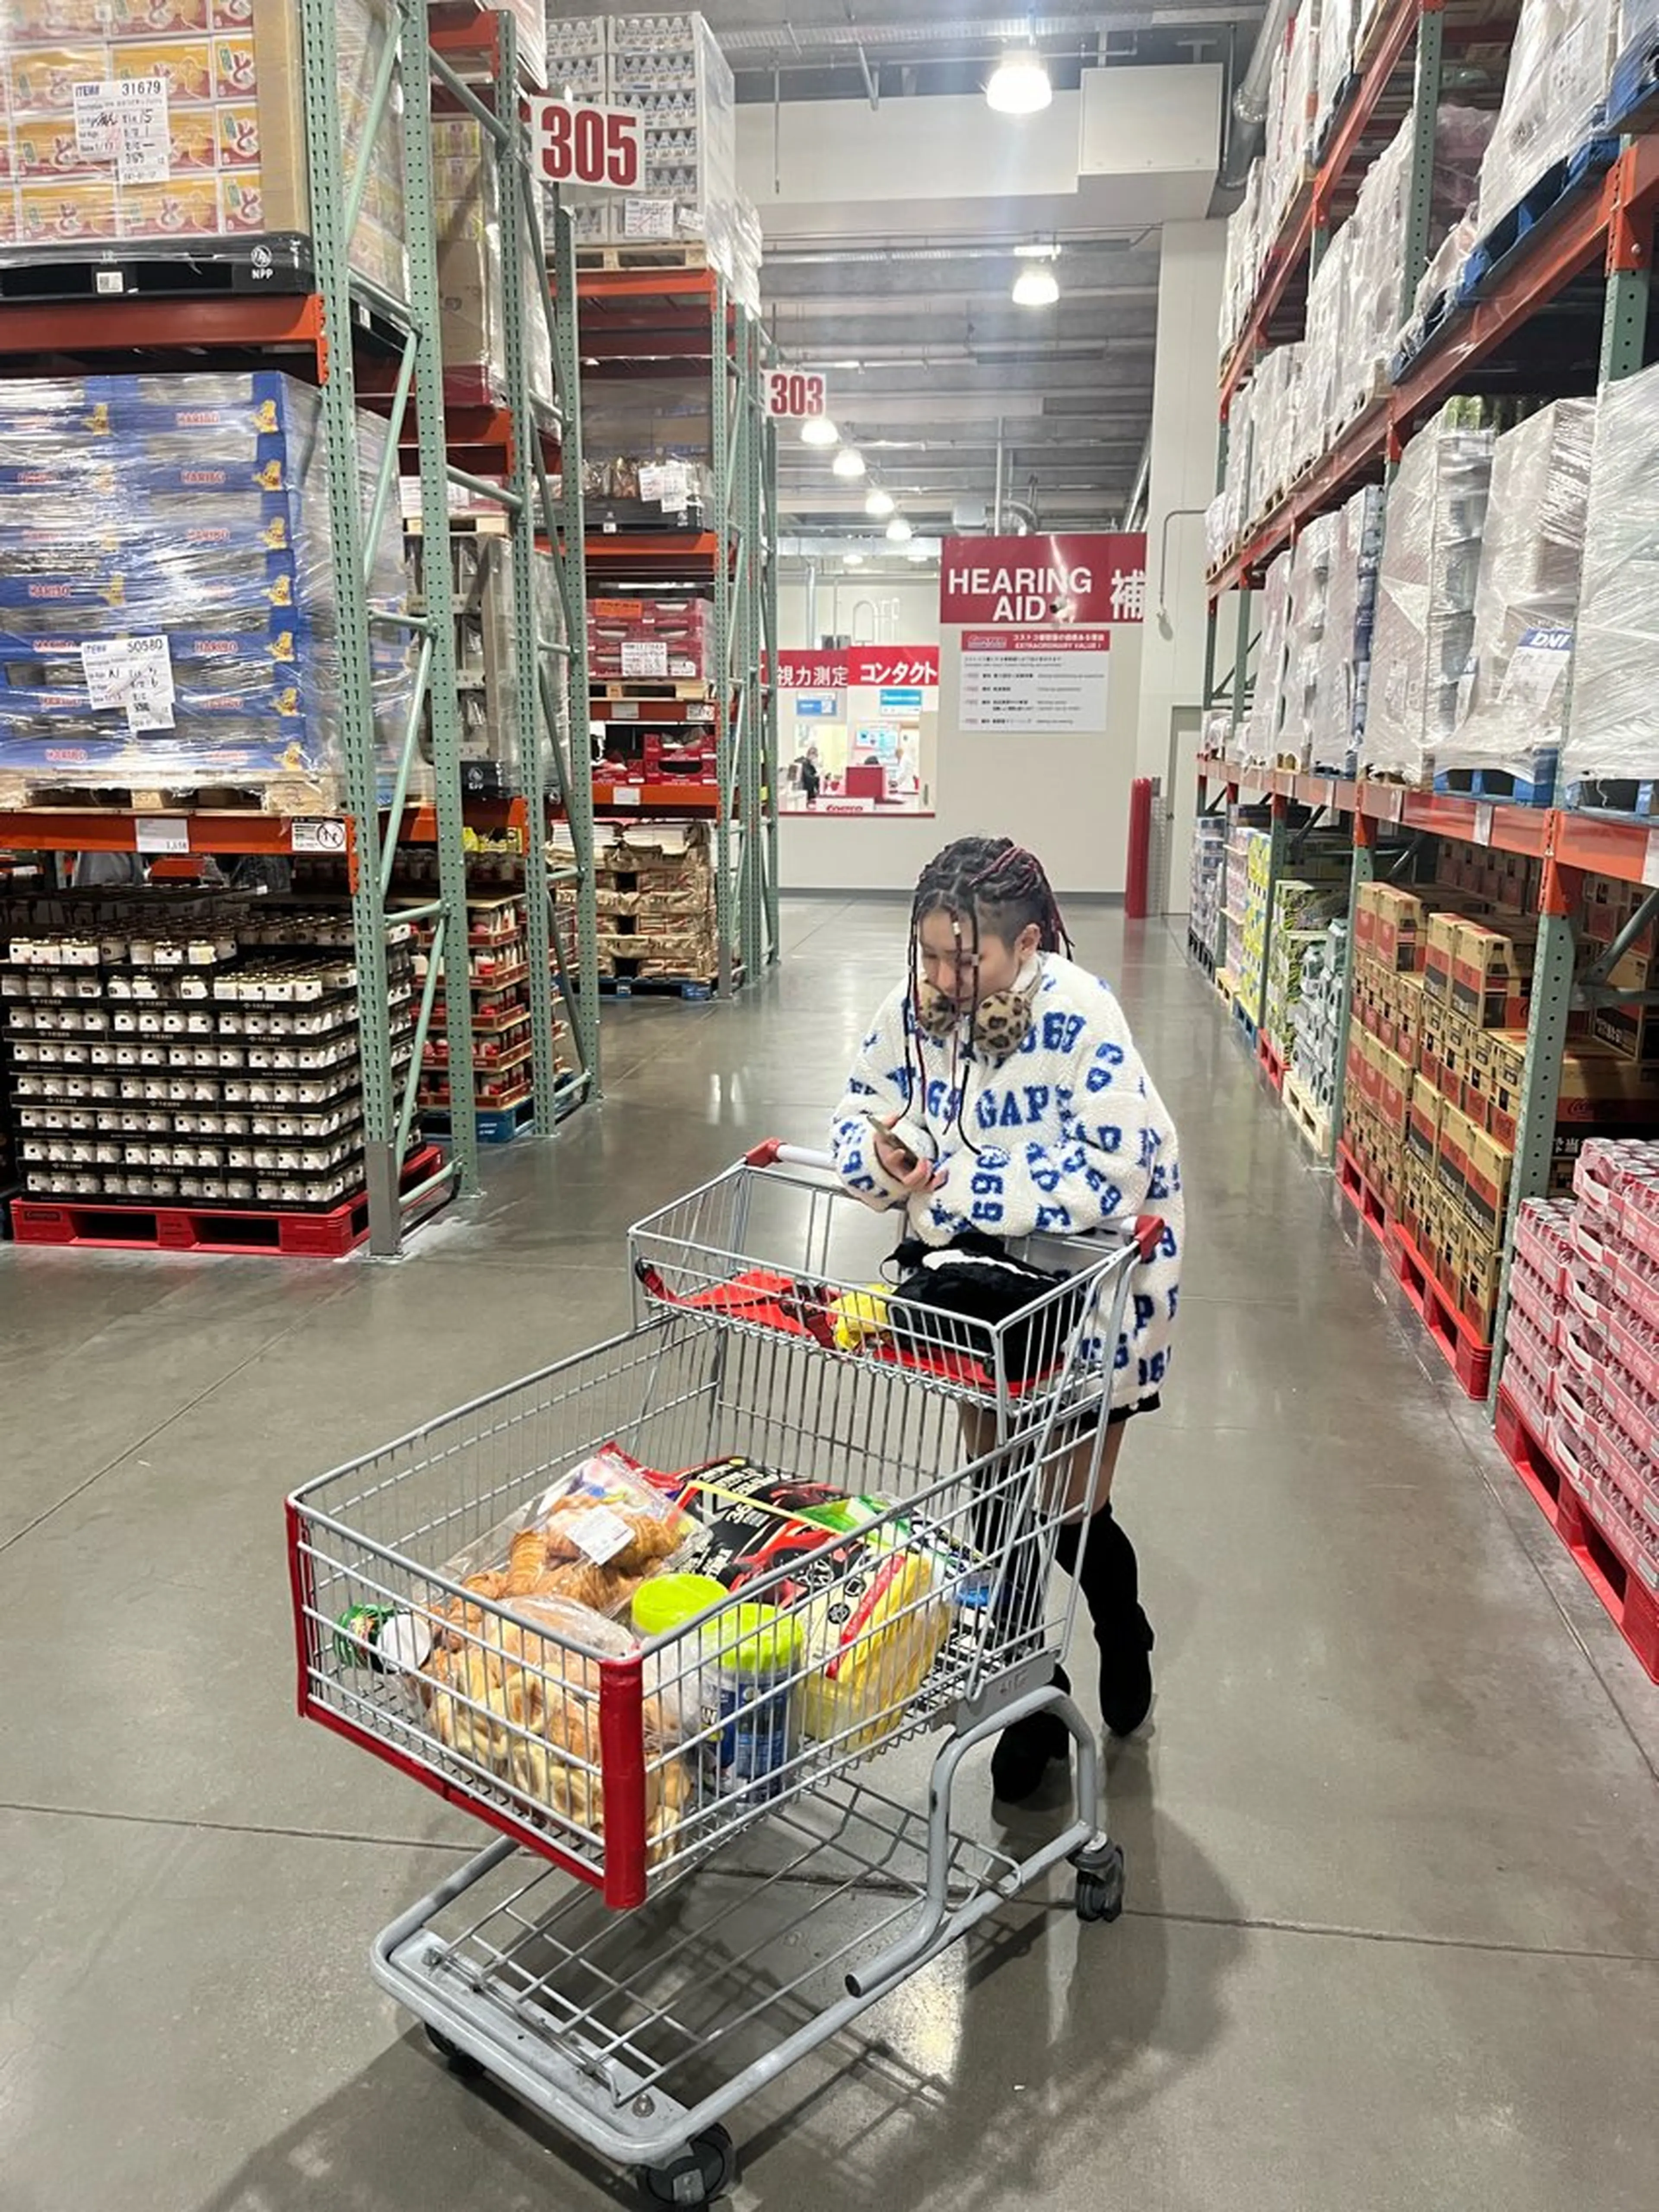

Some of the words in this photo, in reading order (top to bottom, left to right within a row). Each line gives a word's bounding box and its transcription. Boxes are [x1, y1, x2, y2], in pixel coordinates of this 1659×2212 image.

[121, 80, 161, 96] 31679
[541, 106, 637, 186] 305
[771, 374, 823, 416] 303
[949, 567, 1093, 594] HEARING
[993, 596, 1046, 621] AID
[777, 665, 848, 686] 視力測定
[860, 661, 938, 684] コンタクト
[976, 1084, 1049, 1129] GAP
